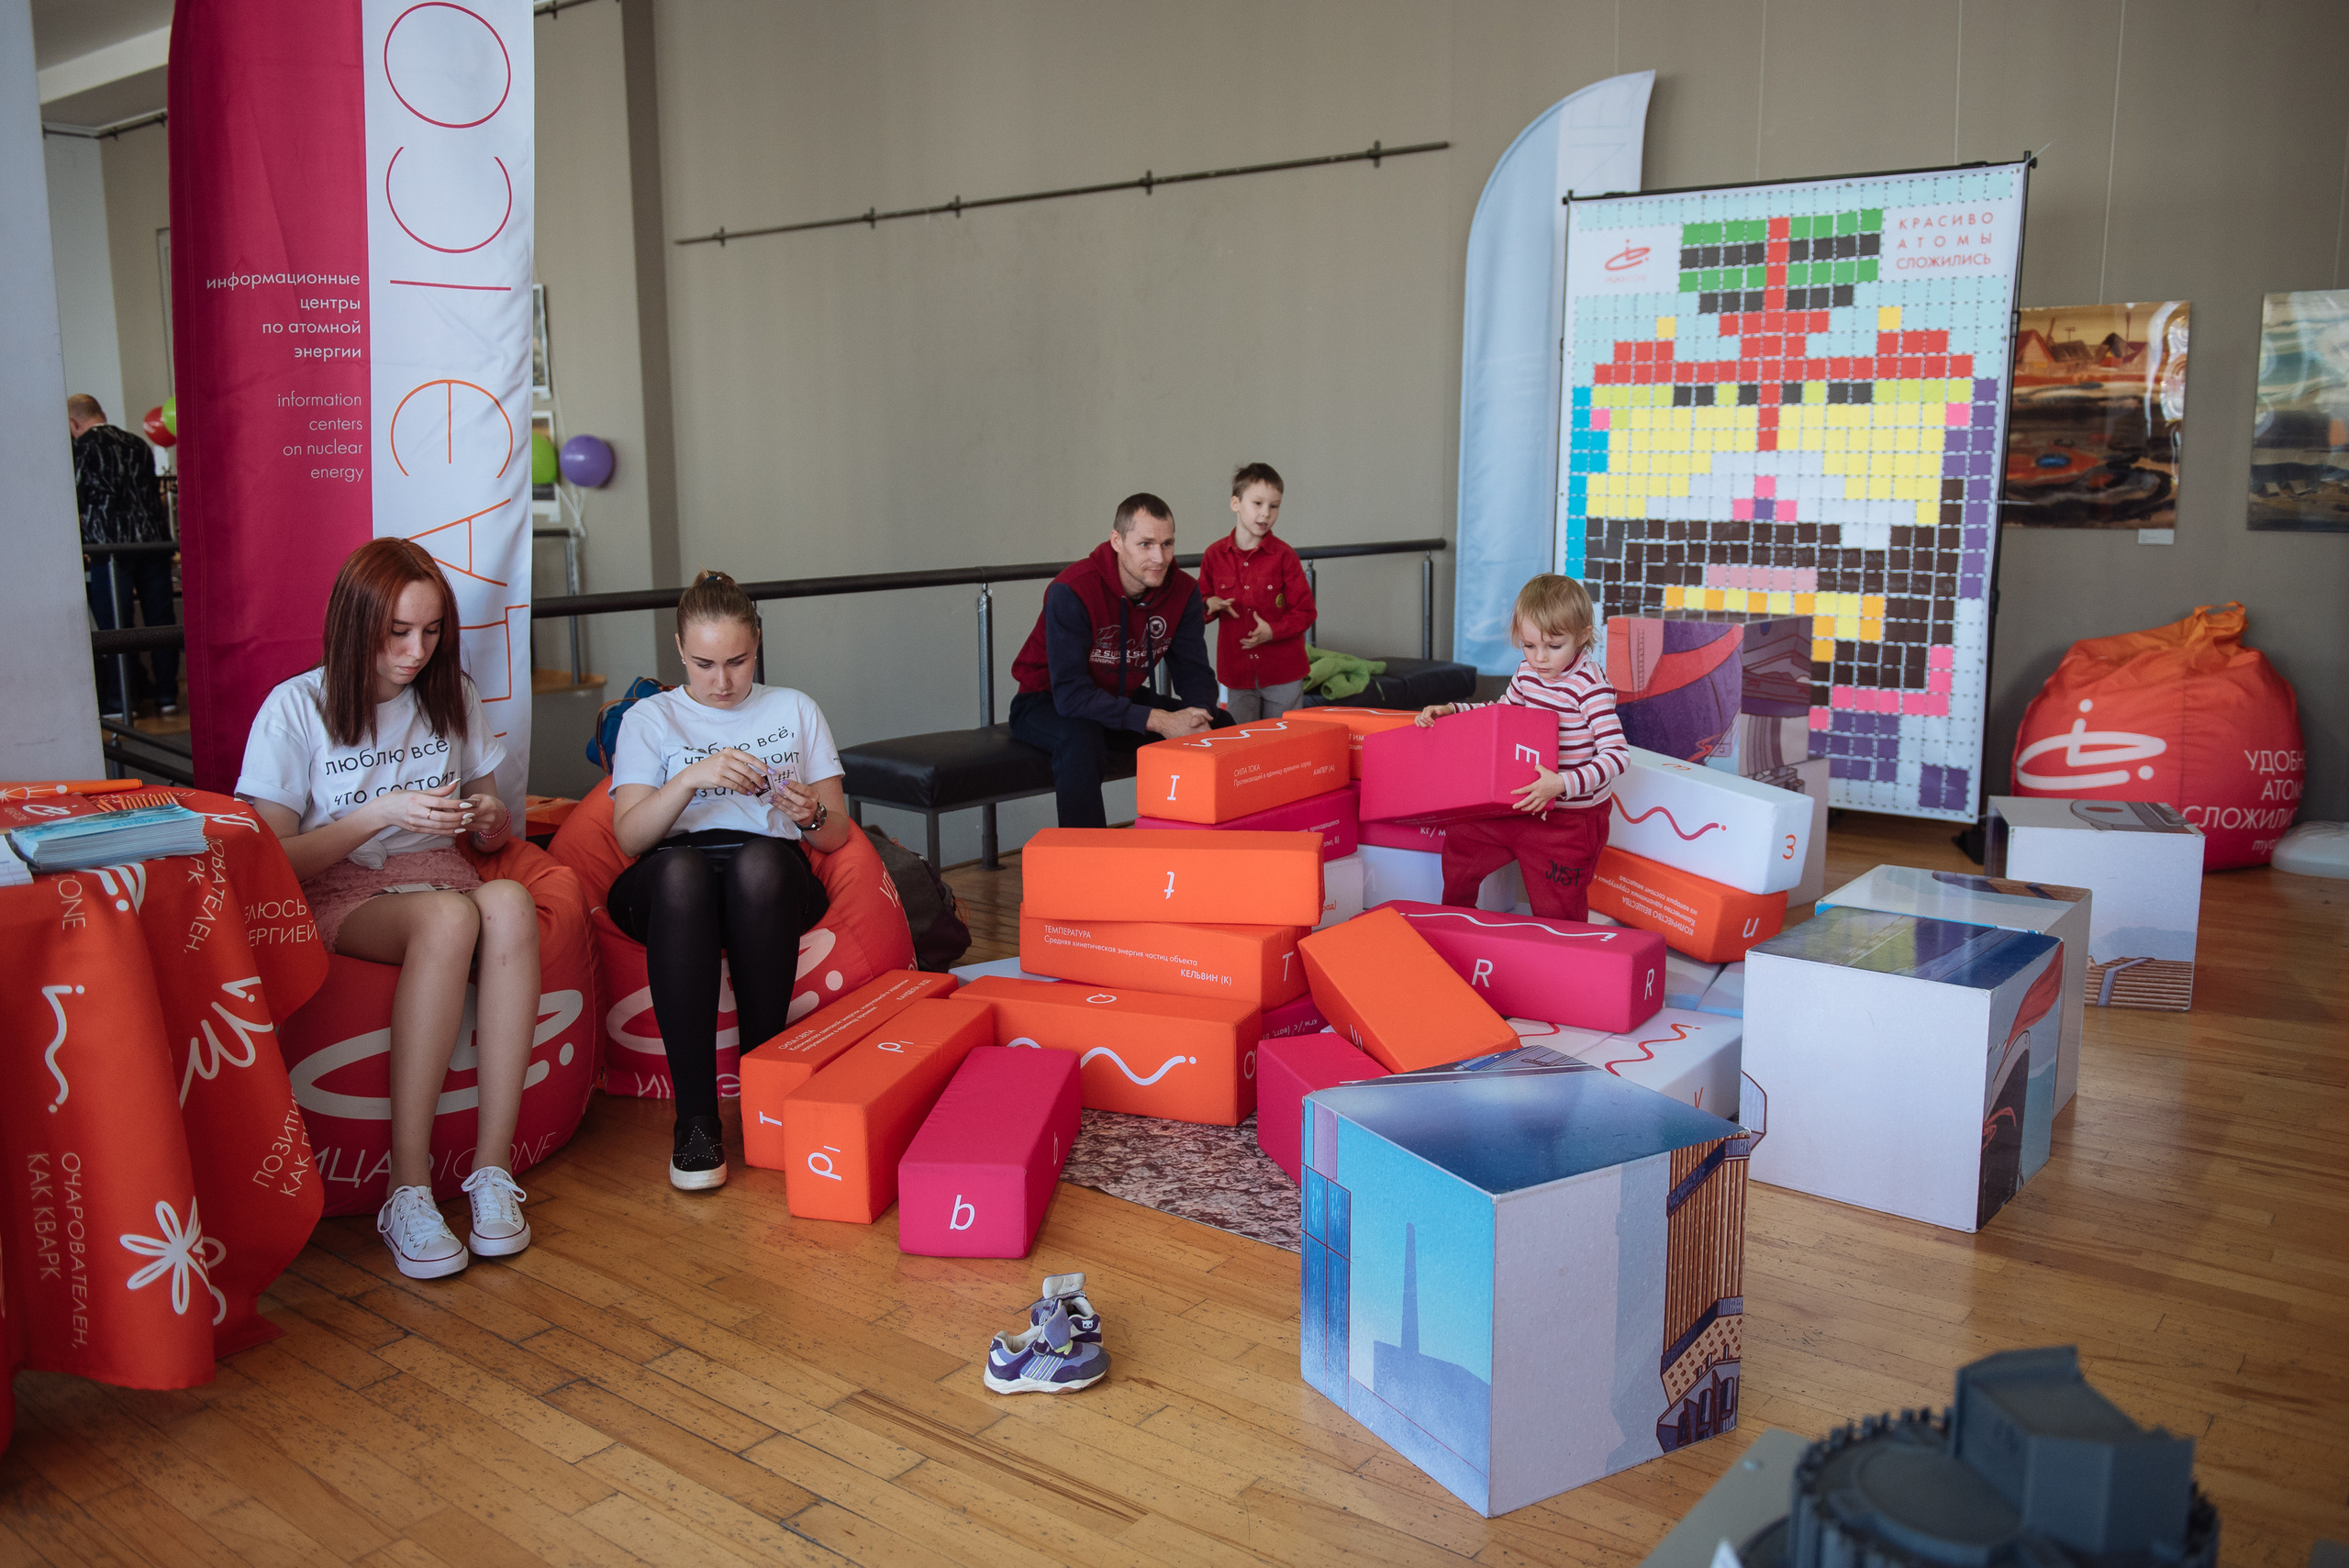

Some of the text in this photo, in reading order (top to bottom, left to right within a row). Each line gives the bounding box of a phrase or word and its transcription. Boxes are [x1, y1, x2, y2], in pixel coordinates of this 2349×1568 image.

[1898, 212, 1994, 229] КРАСИВО
[1897, 232, 1992, 250] АТОМЫ
[1896, 252, 1991, 270] СЛОЖИЛИСЬ
[206, 272, 361, 291] информационные
[299, 295, 361, 314] центры
[262, 319, 361, 334] по атомной
[294, 345, 362, 361] энергии
[277, 390, 362, 407] information
[309, 418, 362, 431] centers
[283, 439, 362, 456] on nuclear
[310, 466, 364, 482] energy
[757, 726, 795, 747] всё,
[325, 748, 405, 776] люблю
[1234, 764, 1261, 777] СИЛА ТОКА
[1313, 766, 1329, 775] АМПЕР
[334, 790, 368, 806] что
[1545, 860, 1584, 887] JUST
[1622, 895, 1694, 936] КОЛИЧЕСТВО ВЕЩЕСТВА
[1664, 905, 1696, 927] Количество
[1044, 925, 1091, 939] ТЕМПЕРАТУРА
[1044, 935, 1197, 966] Средняя кинетическая энергия частиц объекта
[1180, 969, 1232, 985] КЕЛЬВИН (К)
[1471, 959, 1494, 988] R
[1644, 968, 1654, 1000] R
[280, 1153, 310, 1196] КАК
[27, 1153, 61, 1281] КАК КВАРК
[950, 1195, 975, 1230] b
[61, 1152, 88, 1349] ОЧАРОВАТЕЛЕН,
